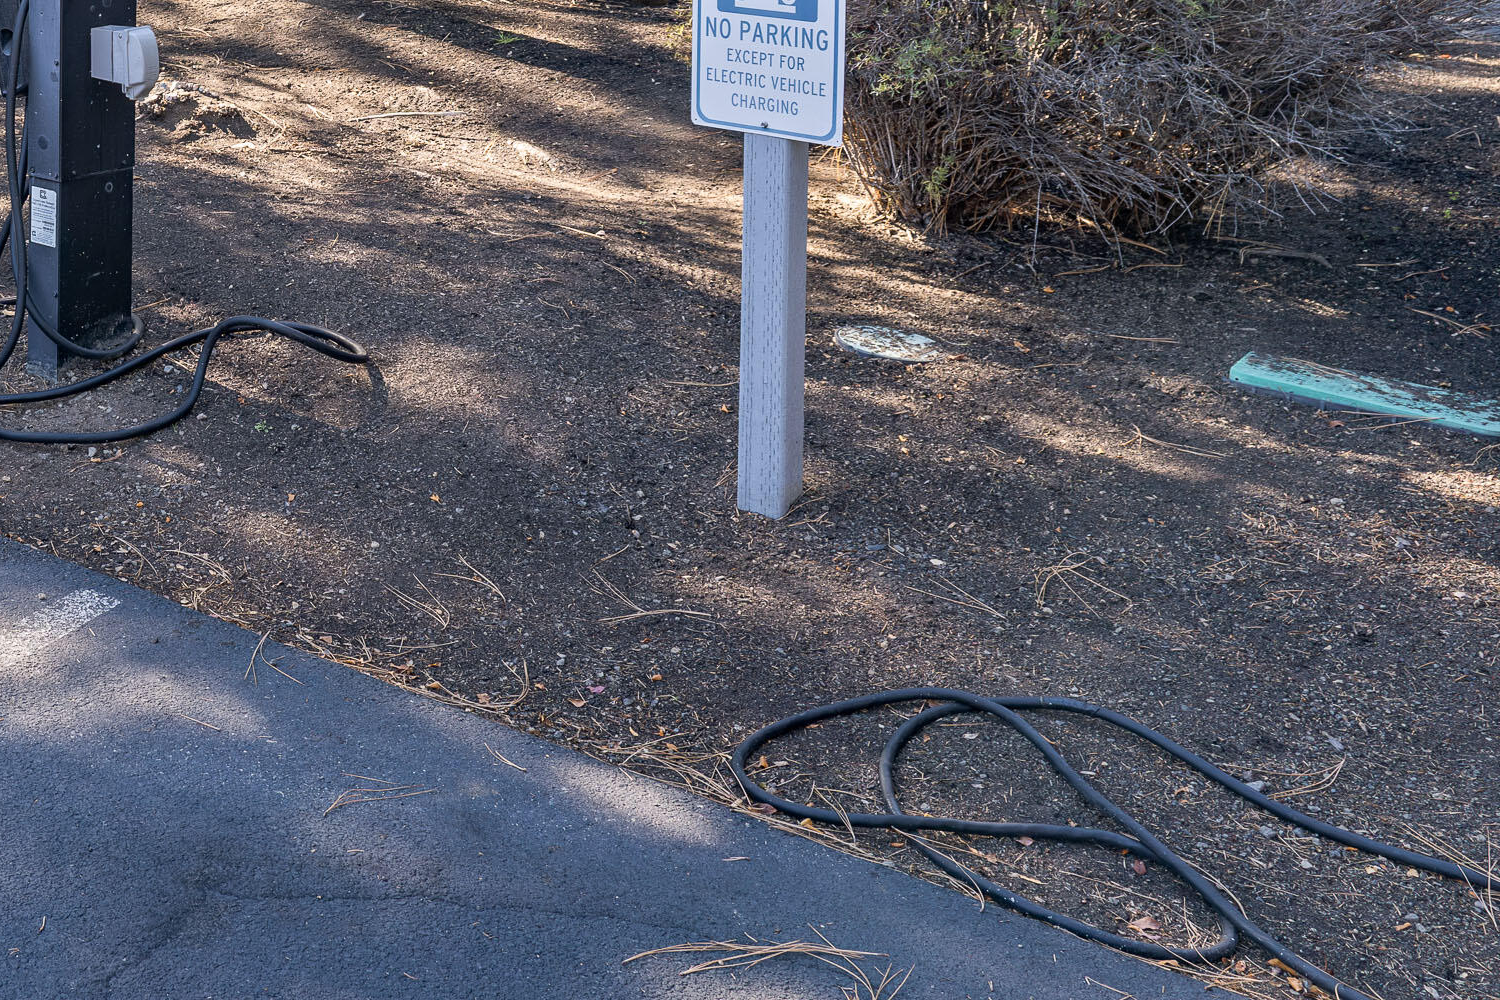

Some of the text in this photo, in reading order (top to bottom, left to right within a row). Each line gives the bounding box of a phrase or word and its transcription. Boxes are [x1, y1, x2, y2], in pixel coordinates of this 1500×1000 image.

[706, 16, 829, 51] NO PARKING
[727, 48, 805, 72] EXCEPT FOR
[706, 67, 827, 97] ELECTRIC VEHICLE
[731, 93, 799, 116] CHARGING
